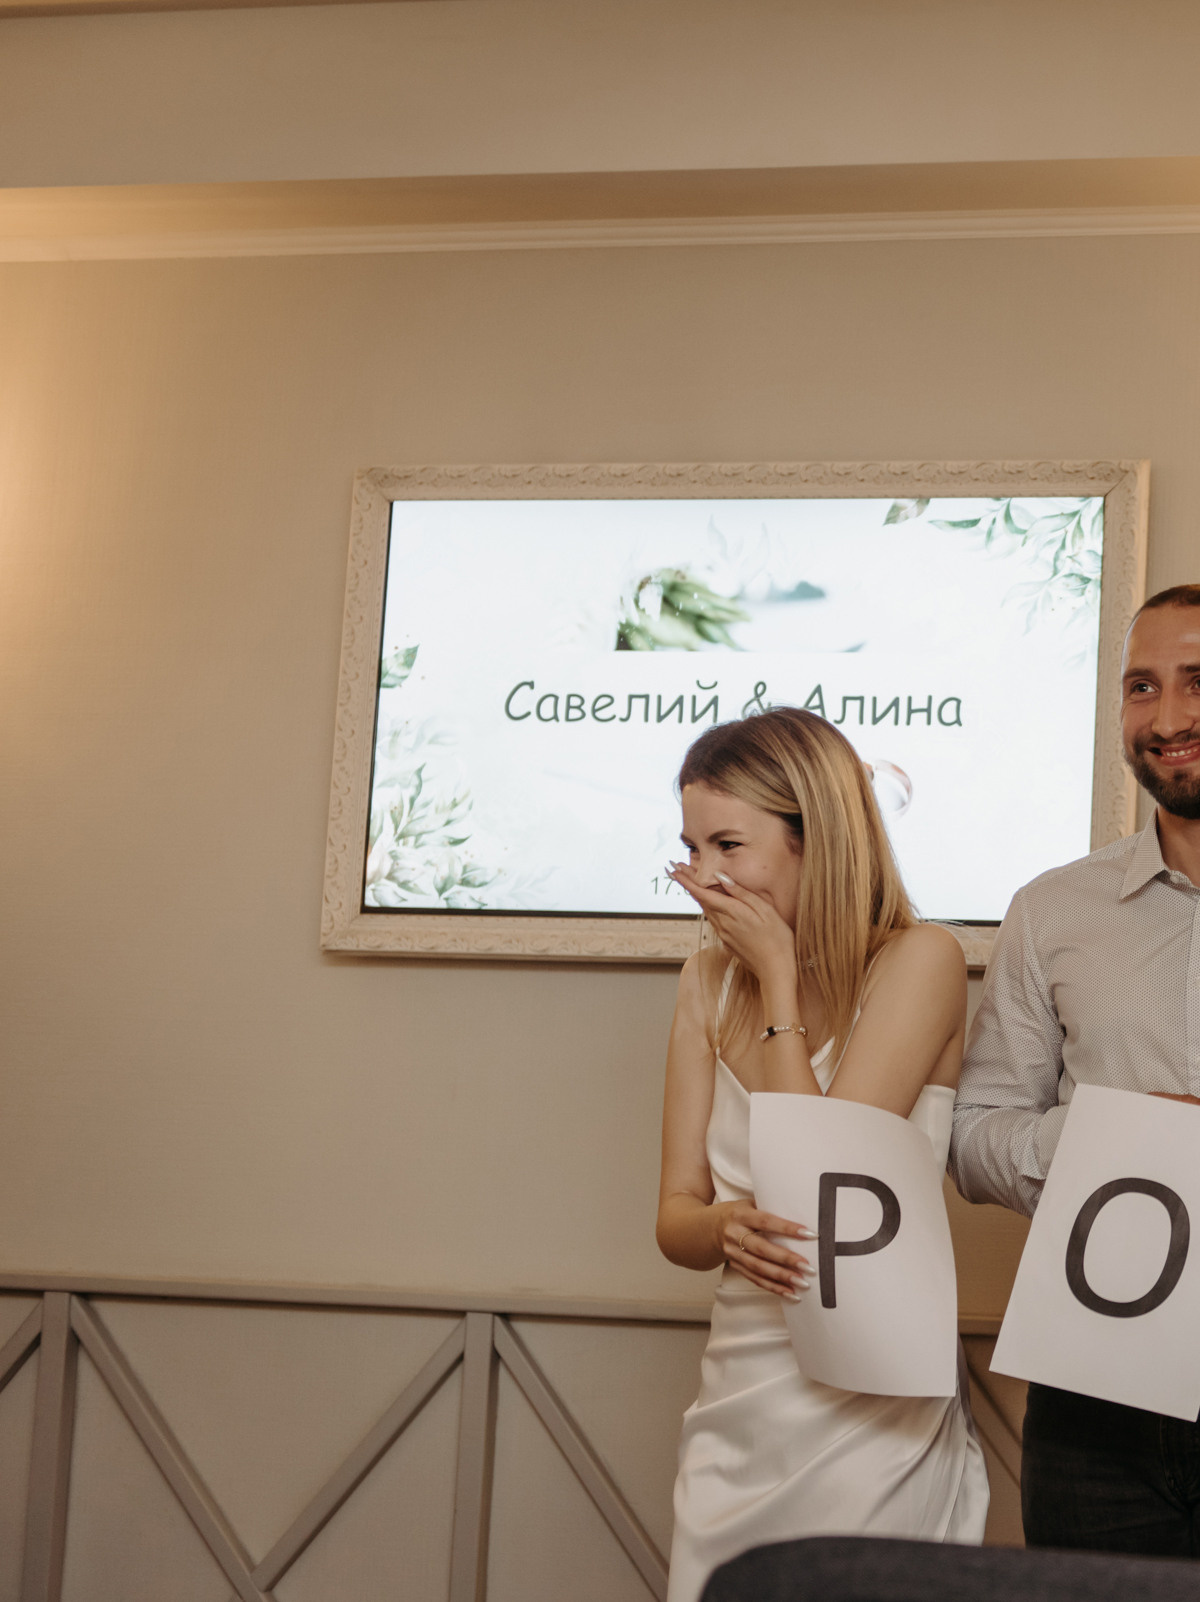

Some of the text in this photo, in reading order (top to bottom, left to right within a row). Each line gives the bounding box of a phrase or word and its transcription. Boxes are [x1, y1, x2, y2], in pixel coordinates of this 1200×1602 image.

[504, 680, 963, 726] Савелий & Алина
[651, 876, 691, 895] 17.
